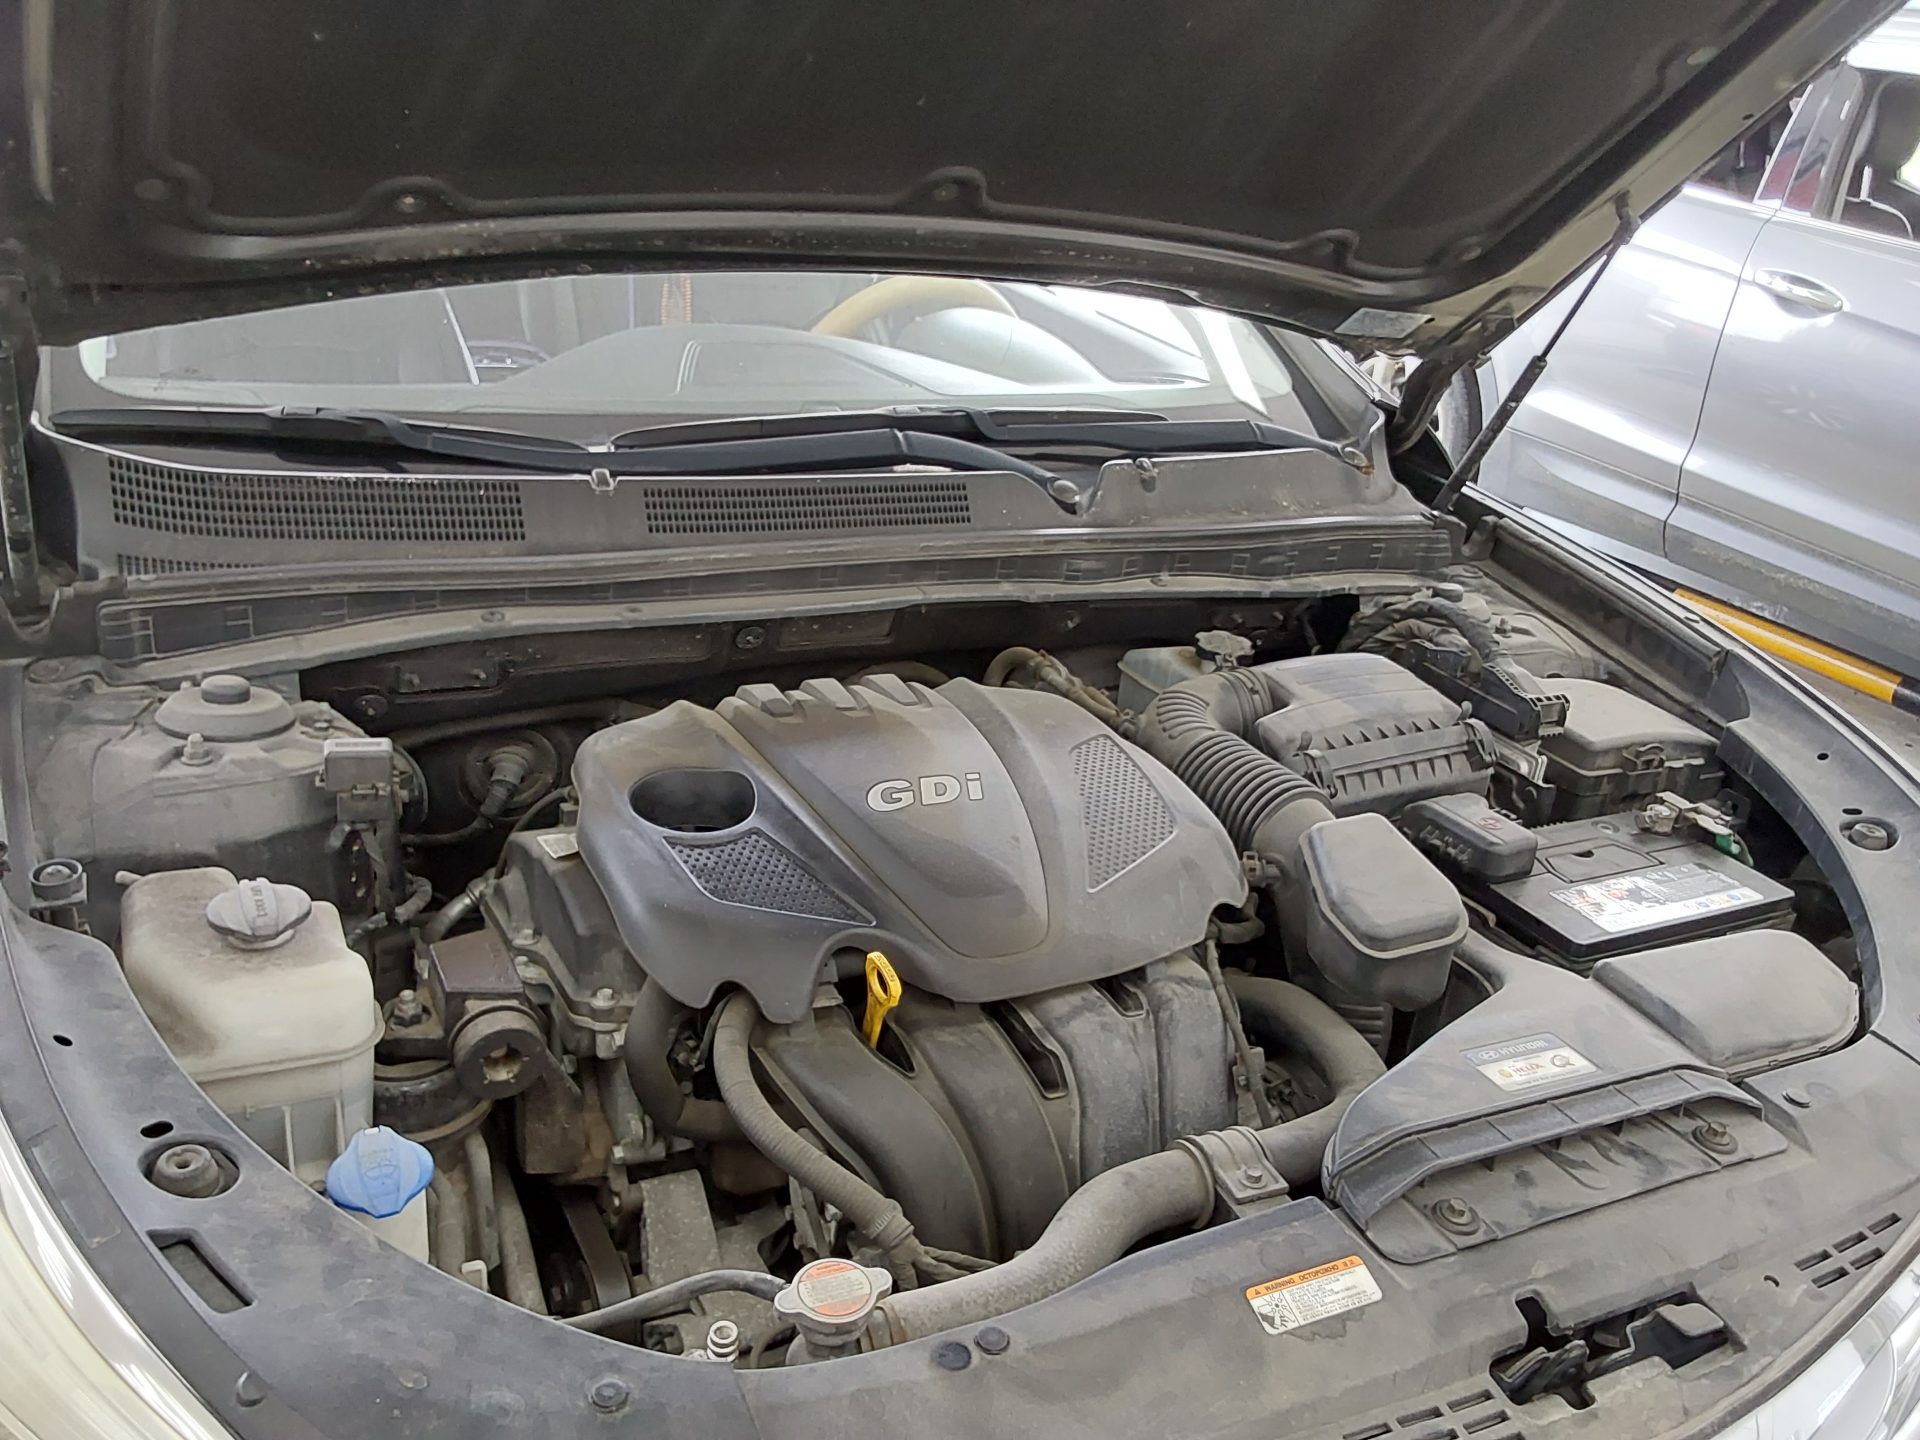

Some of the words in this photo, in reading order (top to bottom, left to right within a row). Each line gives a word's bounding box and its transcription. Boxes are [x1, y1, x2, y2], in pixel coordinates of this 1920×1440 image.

[866, 772, 984, 812] GDi
[1500, 1039, 1549, 1056] HYUNDAI
[1513, 1062, 1545, 1075] HELIX
[1264, 1277, 1295, 1293] WARNING
